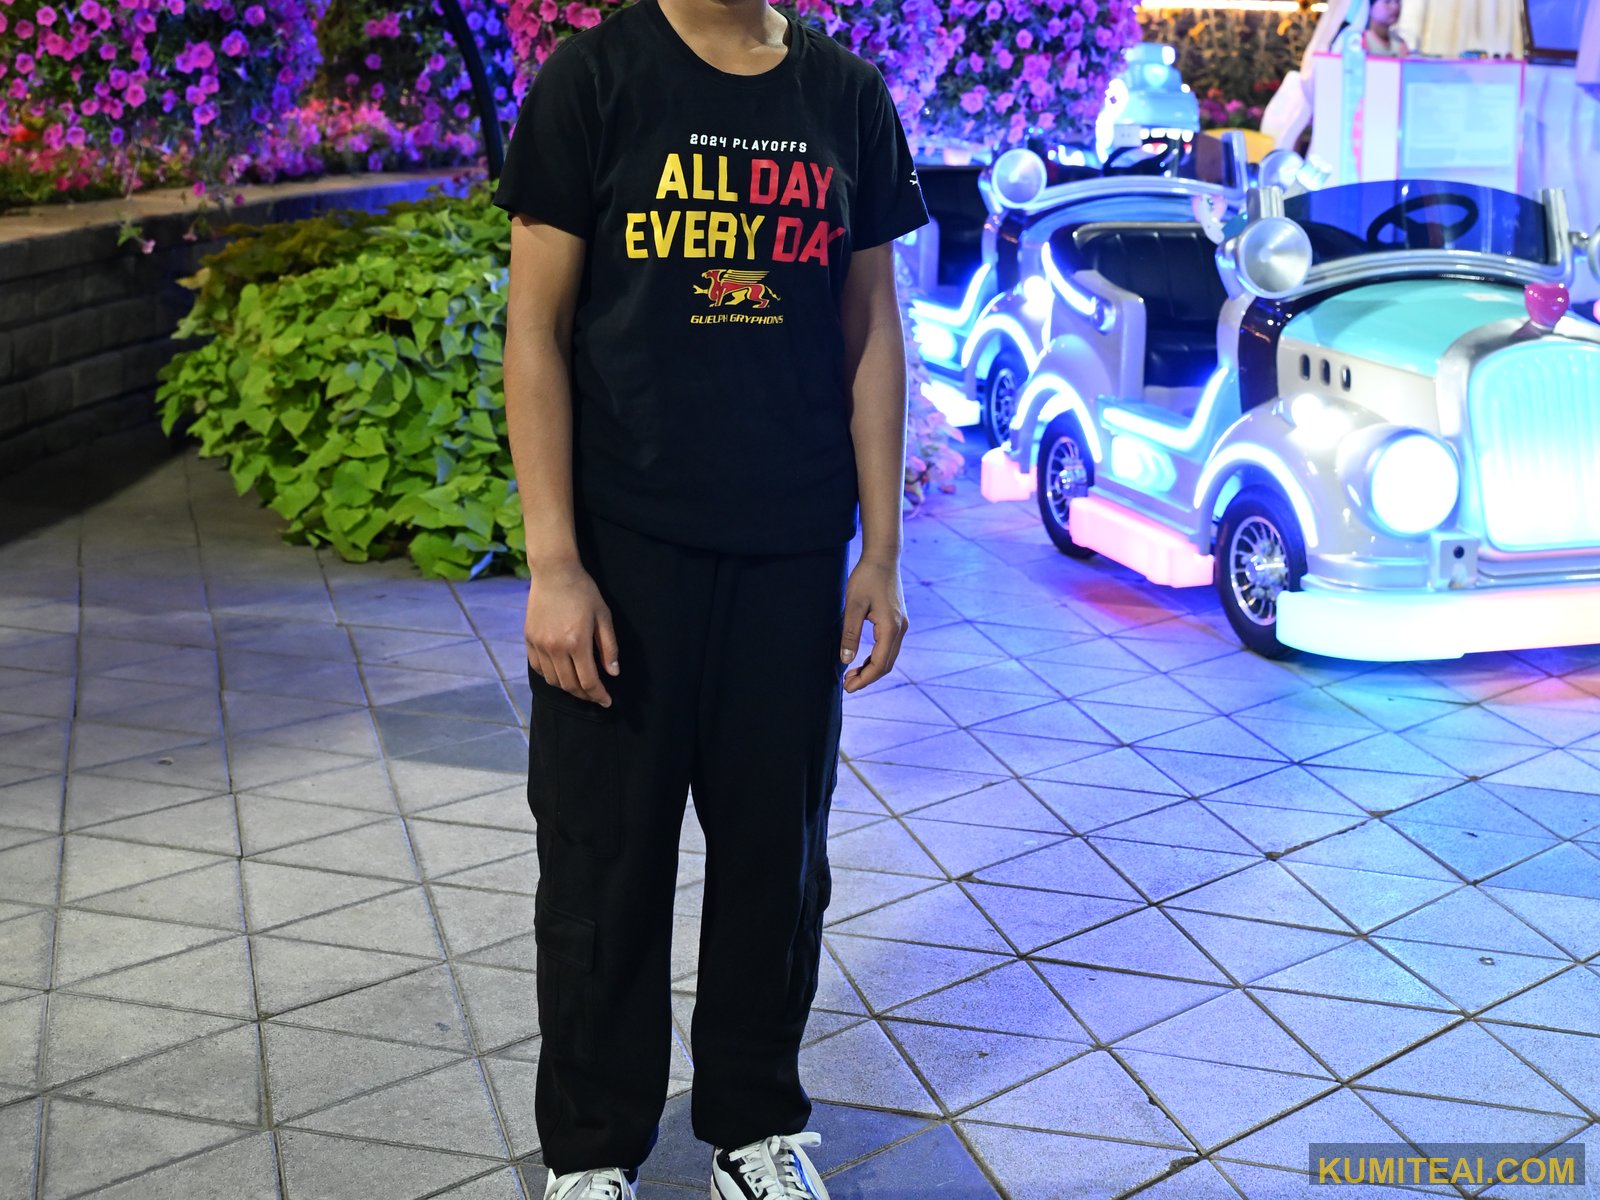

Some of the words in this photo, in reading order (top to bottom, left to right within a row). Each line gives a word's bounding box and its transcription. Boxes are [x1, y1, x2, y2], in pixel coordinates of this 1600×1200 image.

[690, 133, 727, 148] 2024
[732, 138, 808, 153] PLAYOFFS
[655, 153, 738, 202] ALL
[749, 159, 834, 210] DAY
[625, 210, 766, 261] EVERY
[690, 314, 729, 325] GUELPH
[729, 313, 784, 325] GRYPHONS
